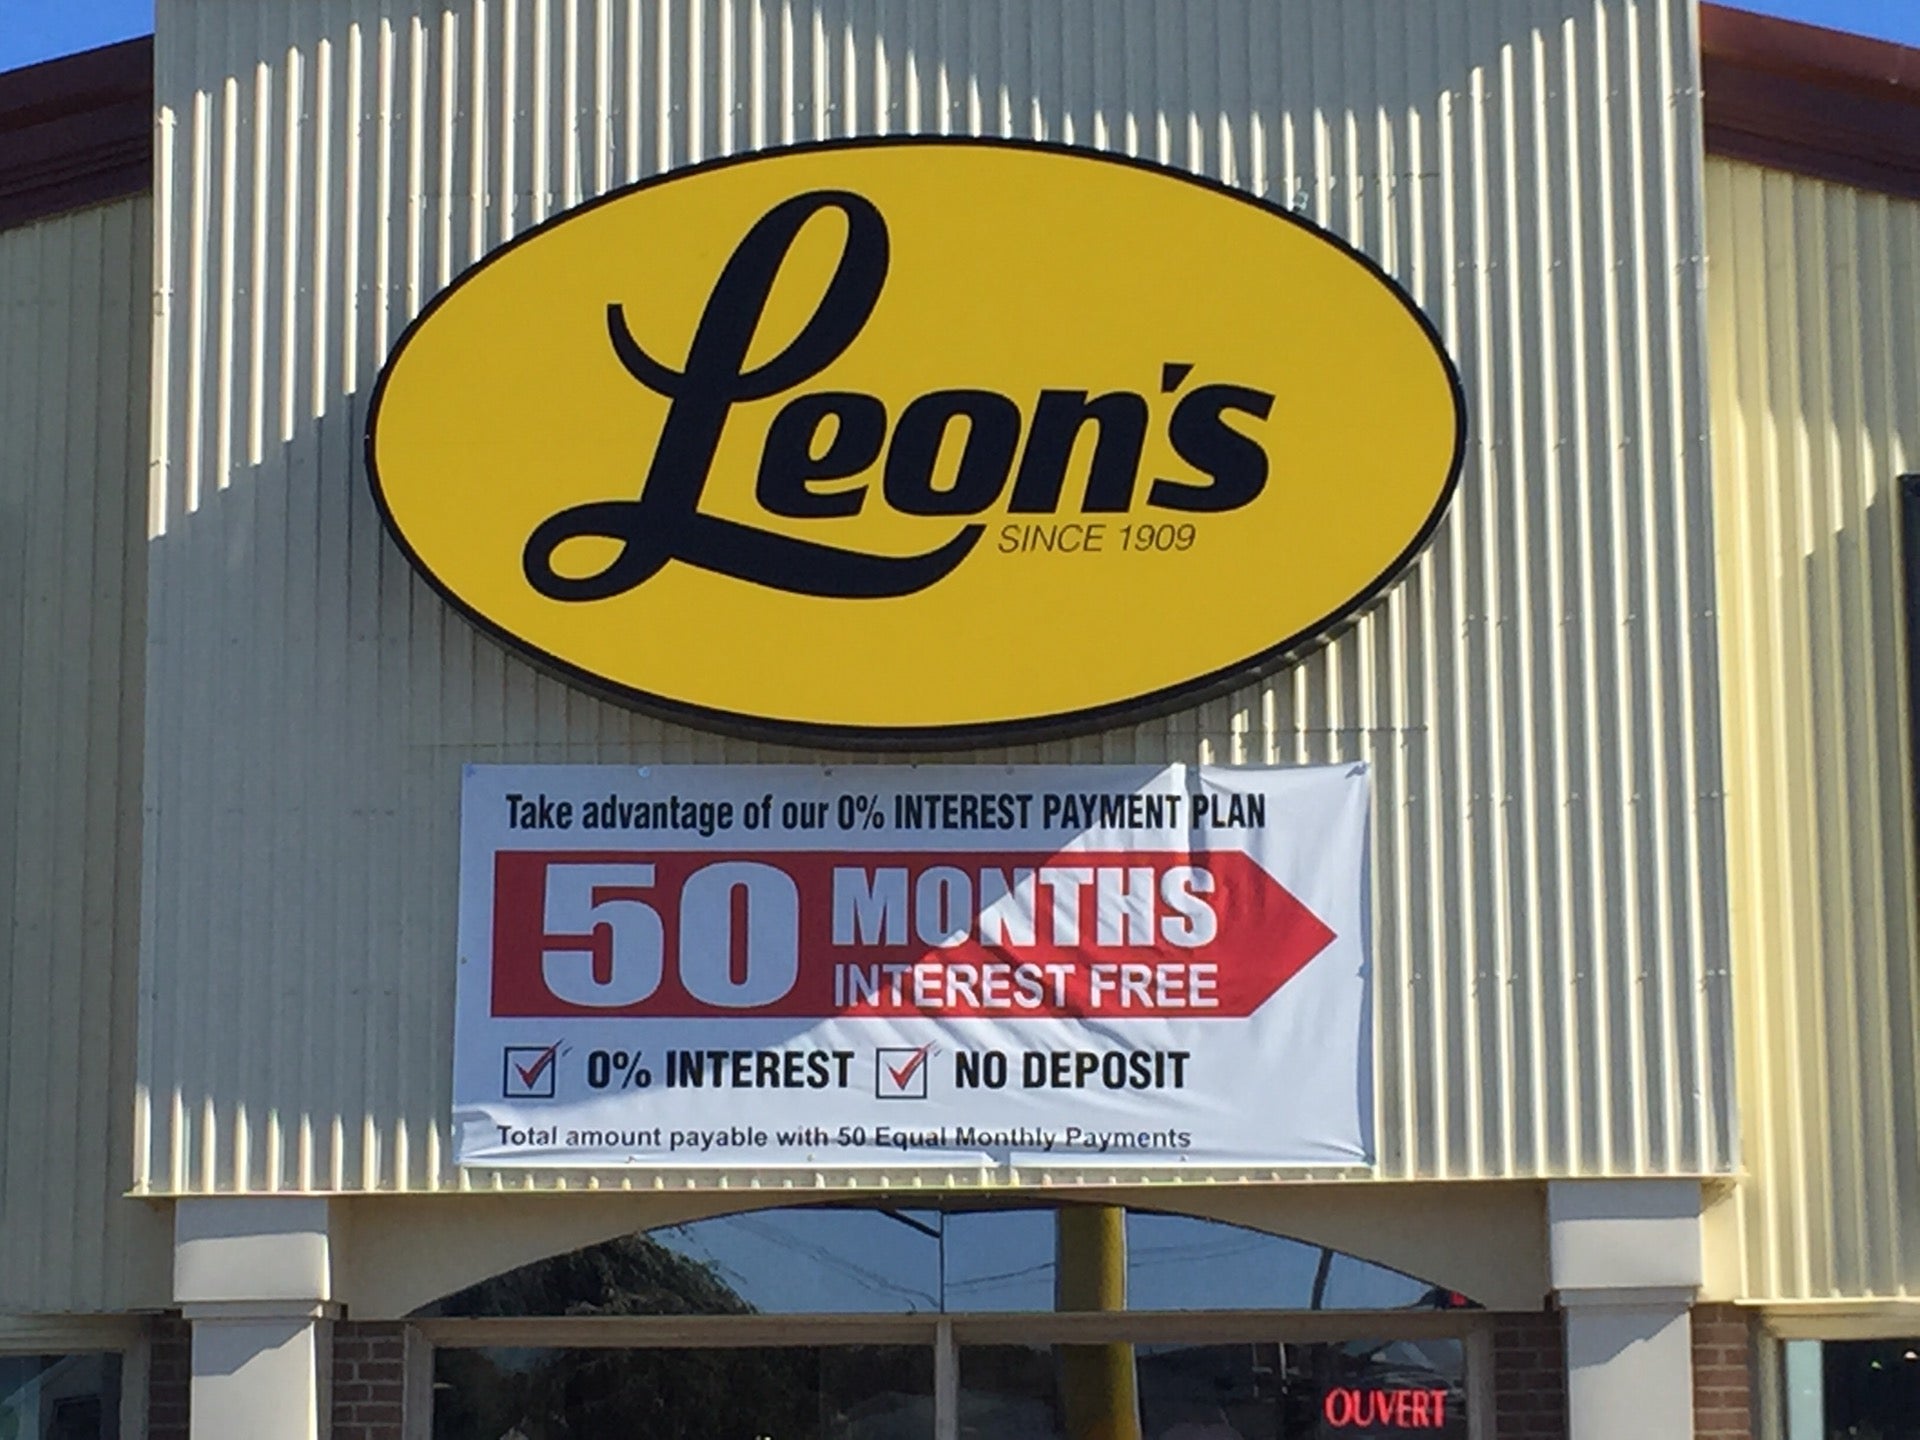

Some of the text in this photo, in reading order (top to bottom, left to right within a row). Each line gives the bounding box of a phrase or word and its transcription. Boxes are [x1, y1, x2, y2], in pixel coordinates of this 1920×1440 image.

[523, 190, 1275, 602] Leon's
[998, 524, 1196, 553] SINCE 1909
[506, 793, 1266, 837] Take advantage of our 0% INTEREST PAYMENT PLAN
[832, 865, 1218, 947] MONTHS
[542, 861, 799, 1008] 50
[834, 963, 1220, 1009] INTEREST FREE
[588, 1051, 855, 1088] 0% INTEREST
[956, 1051, 1190, 1089] NO DEPOSIT
[497, 1126, 1191, 1153] Total amount payable with 50 Equal Monthly Payments
[1325, 1388, 1448, 1428] OUVERT
